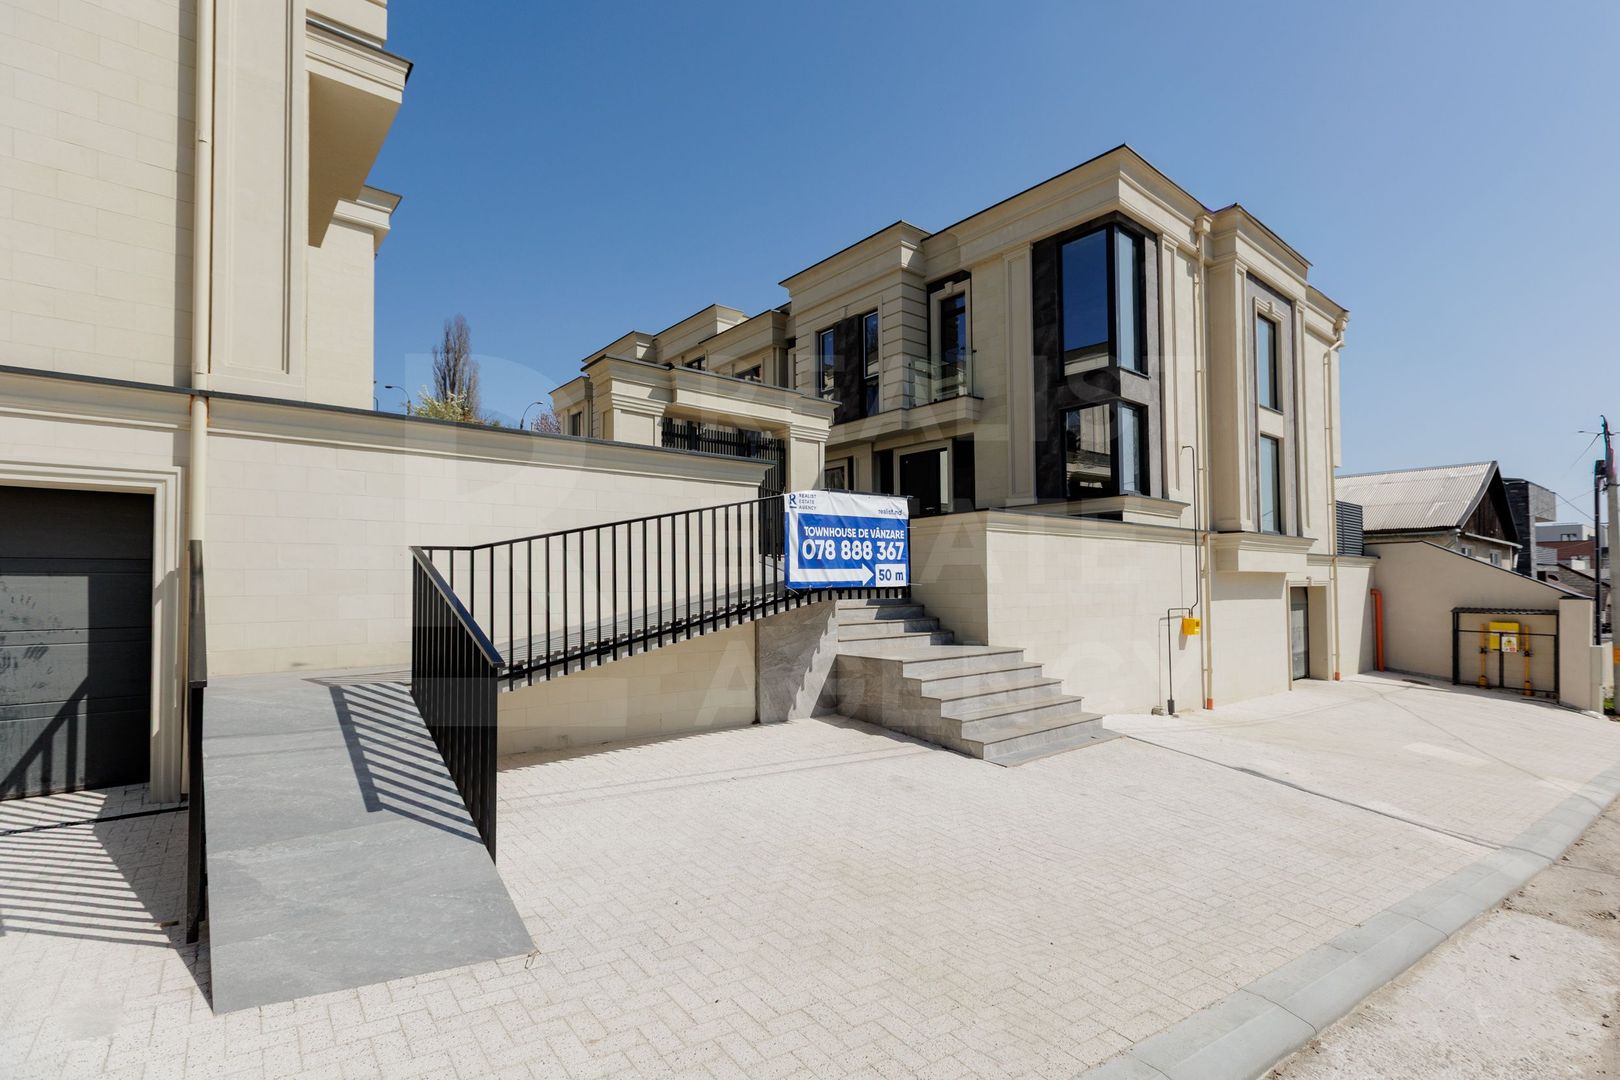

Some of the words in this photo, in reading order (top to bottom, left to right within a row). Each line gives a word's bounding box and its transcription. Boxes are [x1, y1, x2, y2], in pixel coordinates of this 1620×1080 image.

[804, 526, 856, 537] TOWNHOUSE
[858, 529, 869, 538] DE
[870, 527, 905, 539] VÂNZARE
[802, 539, 836, 560] 078
[841, 540, 873, 560] 888
[877, 541, 904, 560] 367
[879, 569, 892, 581] 50
[895, 572, 904, 580] m
